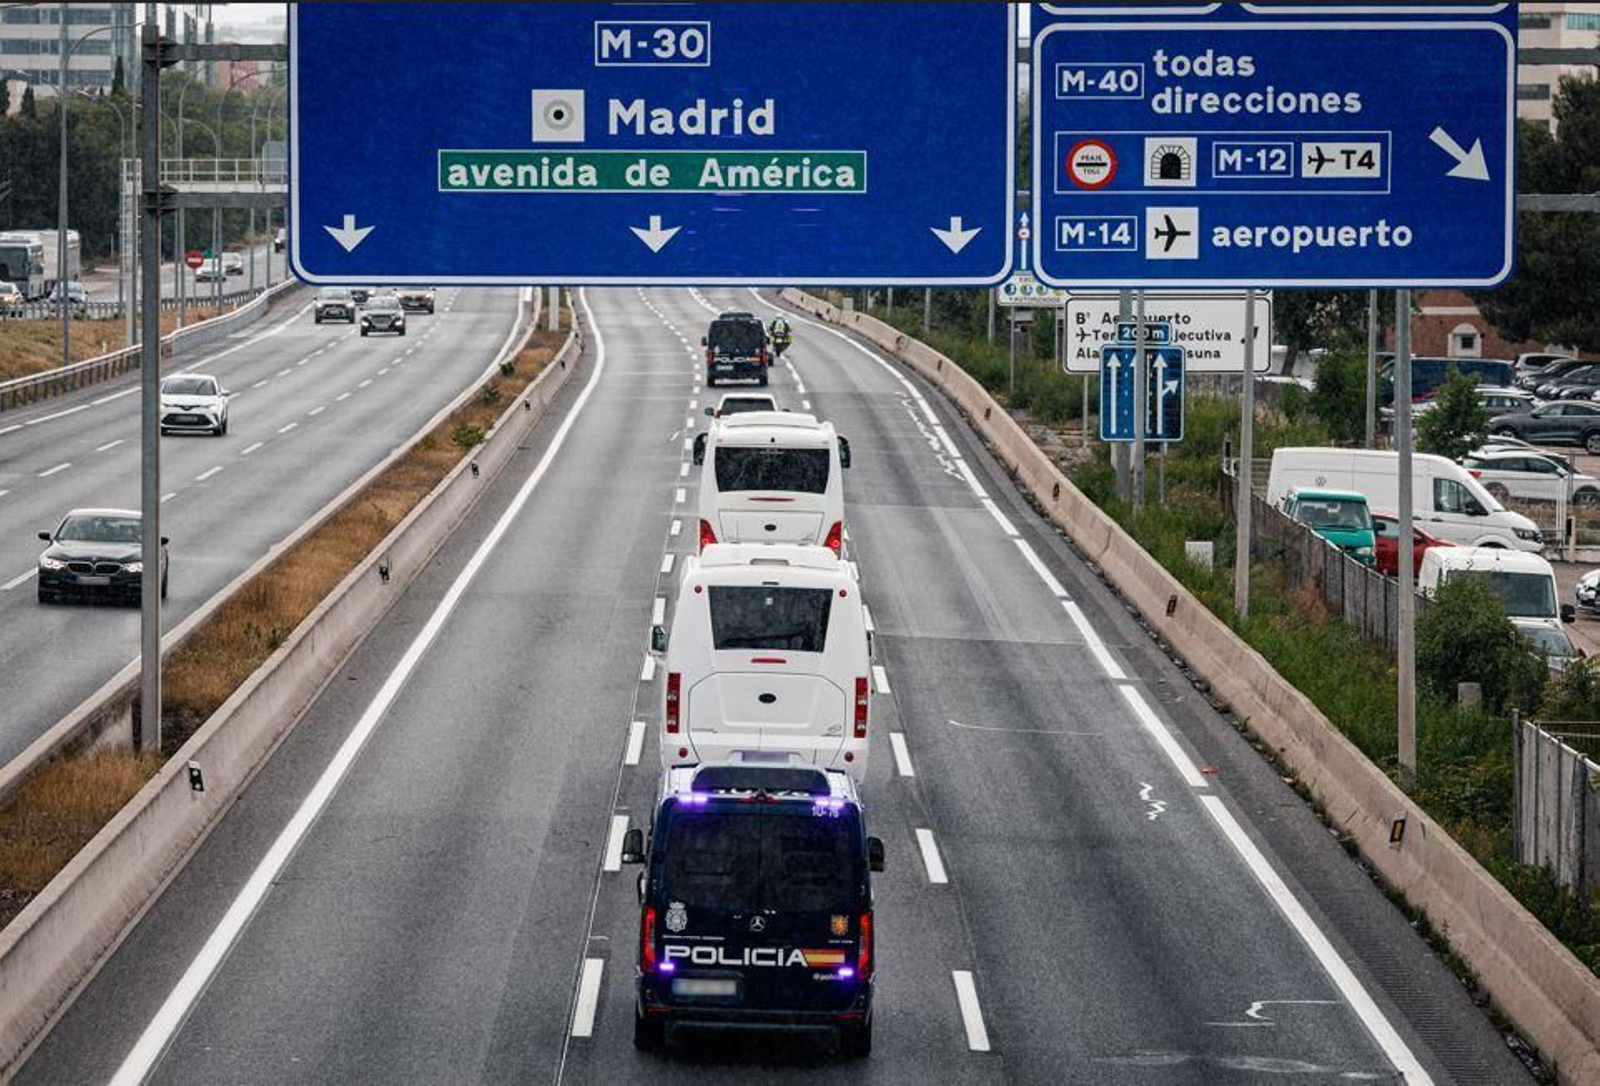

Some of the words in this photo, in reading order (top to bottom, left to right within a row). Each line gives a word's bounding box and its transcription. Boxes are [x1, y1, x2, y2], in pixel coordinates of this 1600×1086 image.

[601, 28, 704, 60] M-30
[1153, 49, 1255, 77] todas
[1062, 69, 1138, 92] M-40
[1151, 86, 1362, 114] direcciones
[608, 98, 775, 136] Madrid
[448, 157, 598, 187] avenida
[625, 158, 670, 188] de
[698, 157, 856, 188] América
[1219, 148, 1286, 171] M-12
[1340, 149, 1376, 170] T4
[1062, 222, 1131, 245] M-14
[1212, 219, 1413, 253] aeropuerto
[1172, 329, 1232, 343] jecutiva
[1186, 349, 1221, 360] suna
